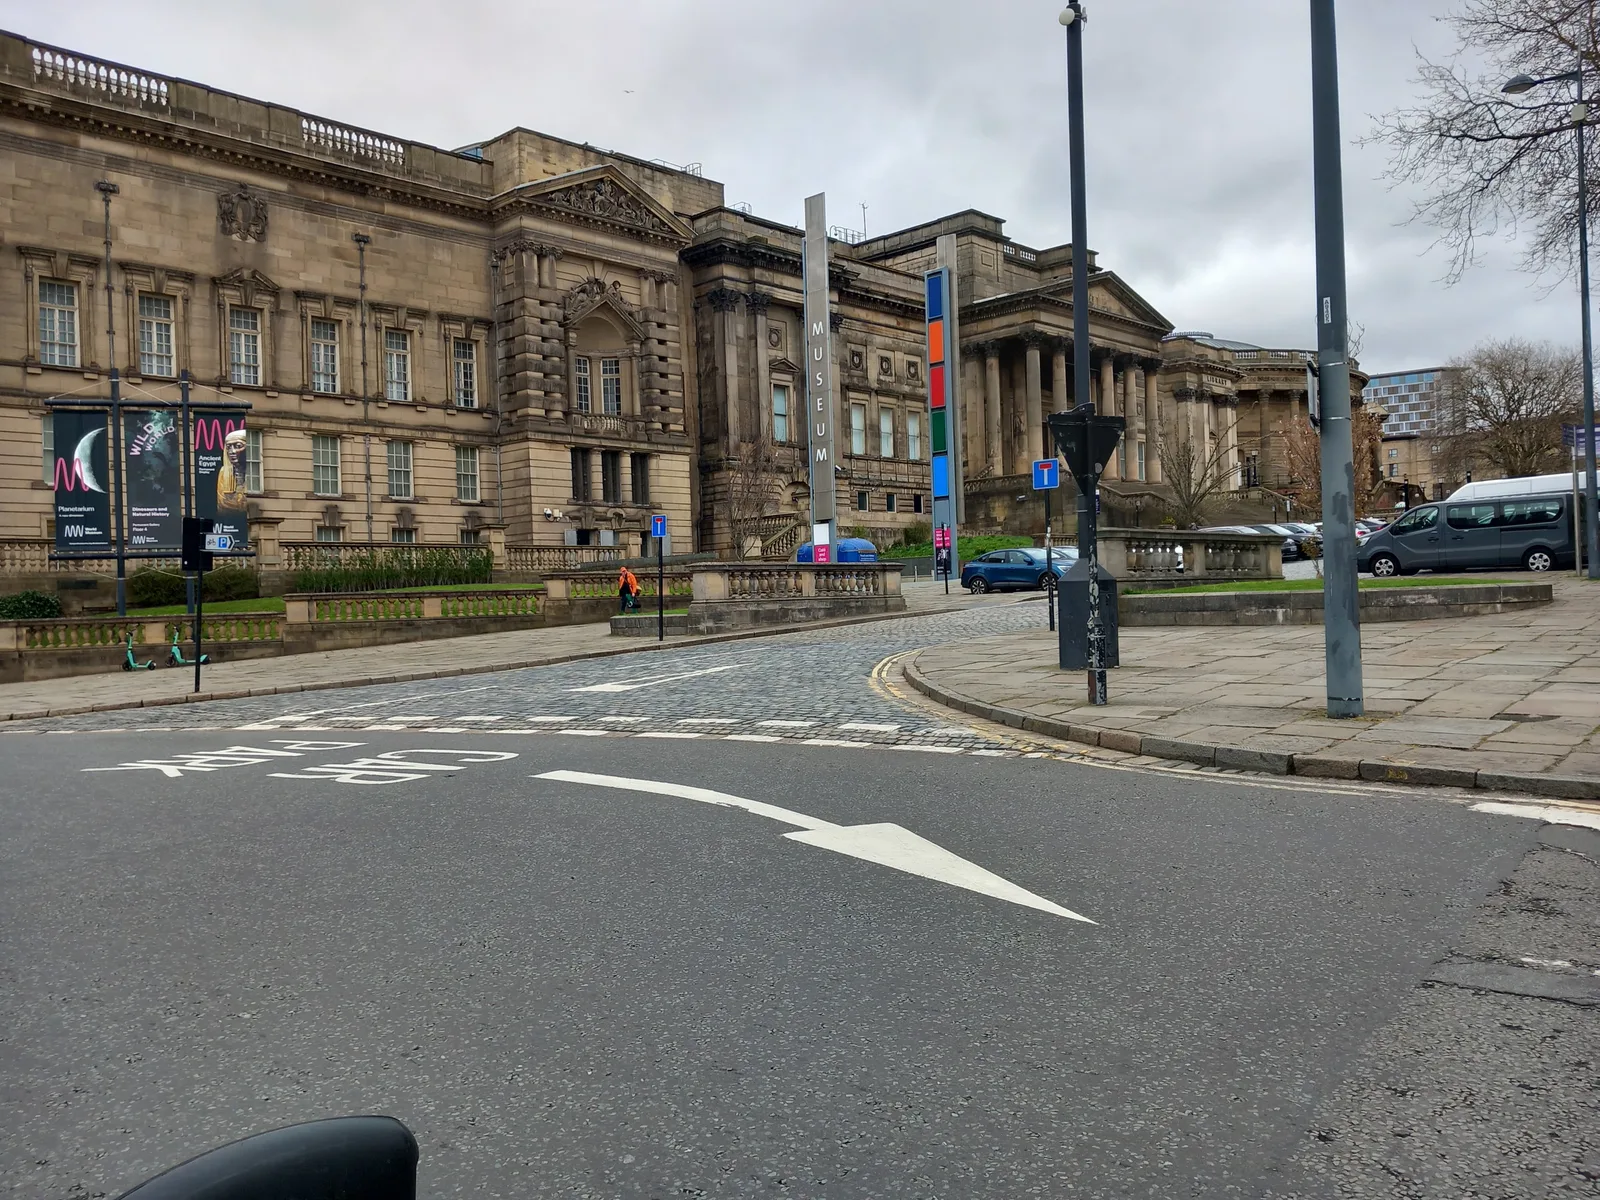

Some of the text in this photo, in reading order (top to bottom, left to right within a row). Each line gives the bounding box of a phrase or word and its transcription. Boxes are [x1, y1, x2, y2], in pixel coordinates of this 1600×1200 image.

[812, 321, 828, 462] MUSEUM
[129, 422, 155, 456] WILD
[144, 425, 175, 451] WORLD
[220, 537, 227, 547] P
[80, 739, 369, 778] PARK
[266, 748, 519, 785] CAR
